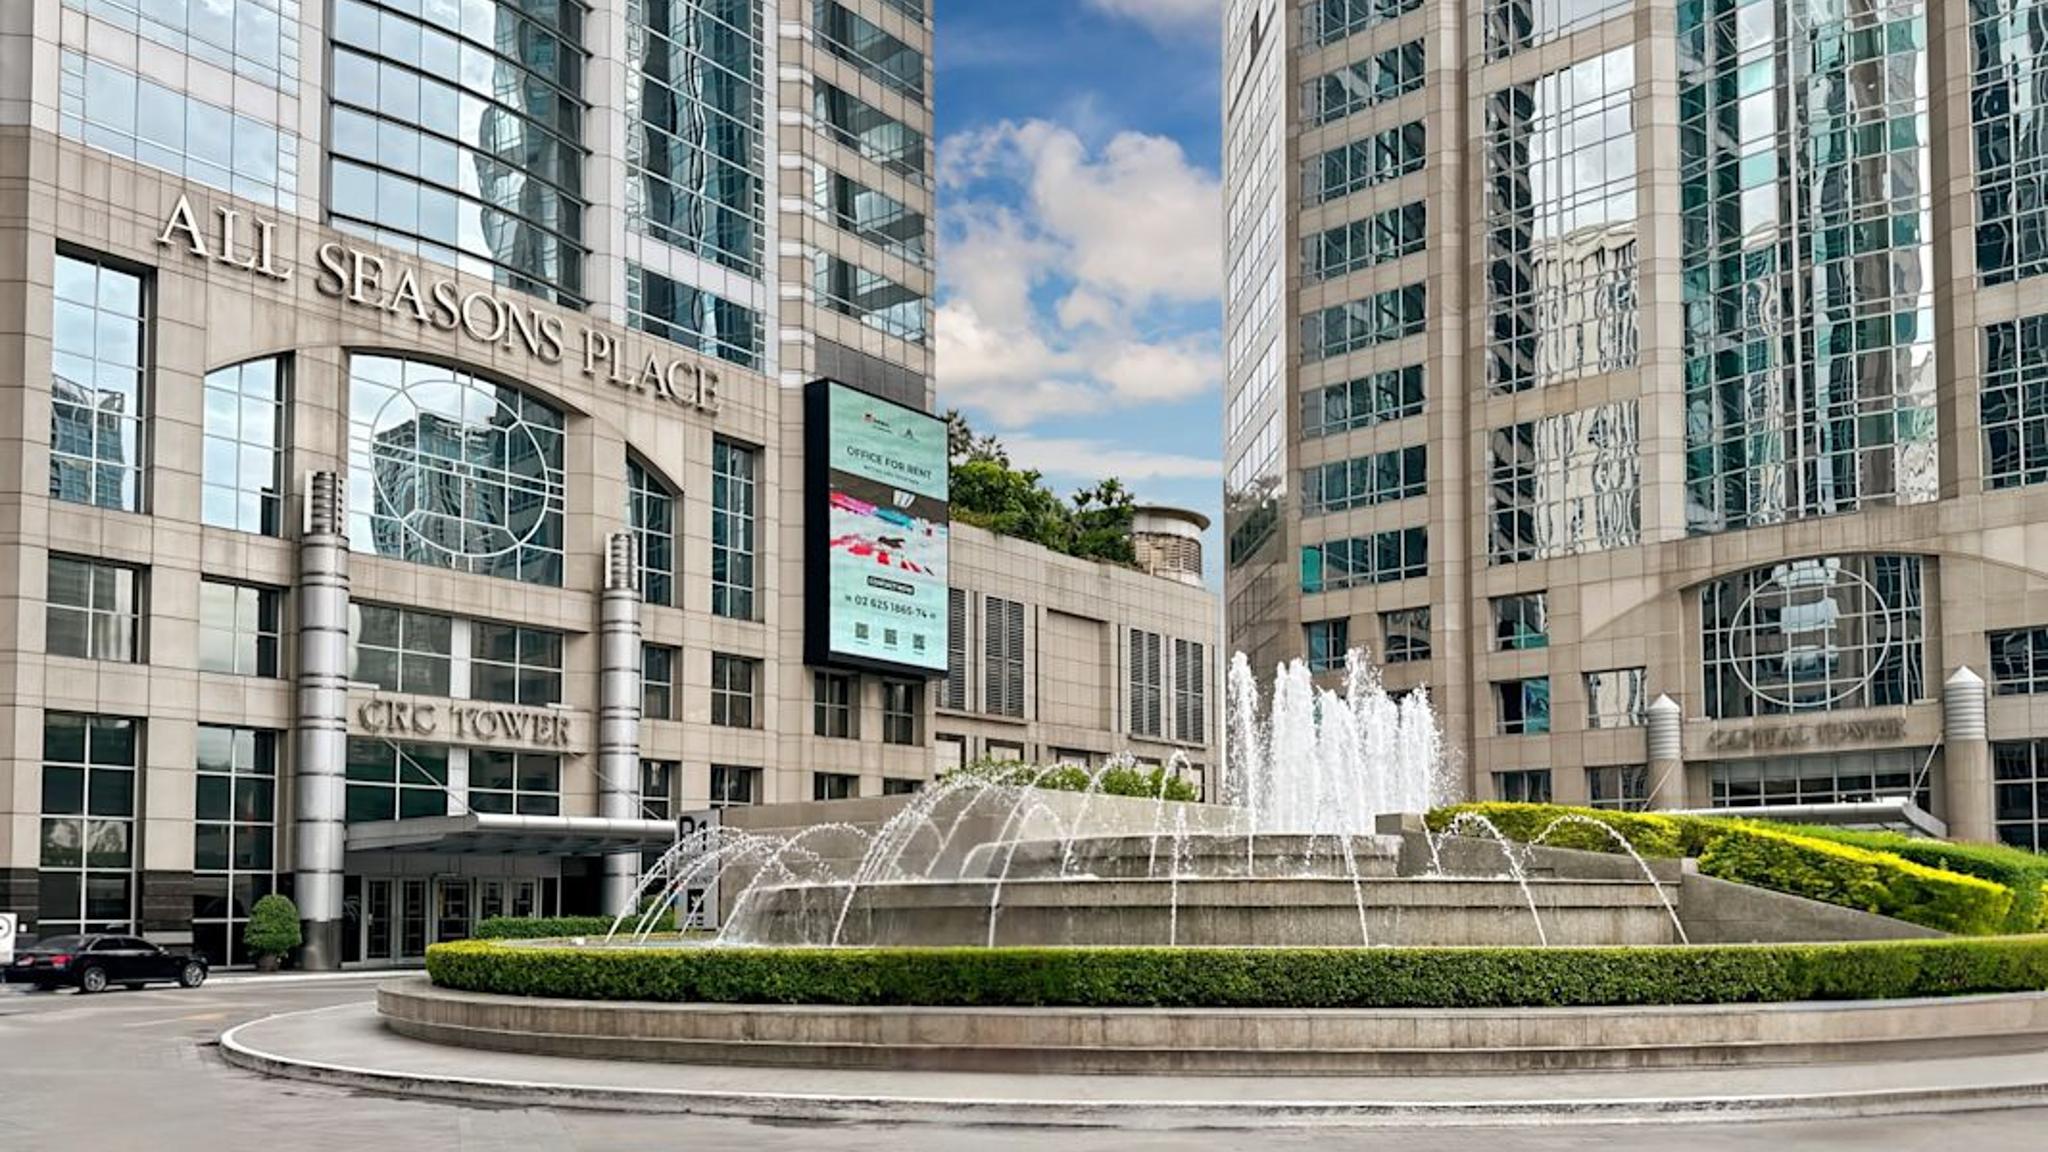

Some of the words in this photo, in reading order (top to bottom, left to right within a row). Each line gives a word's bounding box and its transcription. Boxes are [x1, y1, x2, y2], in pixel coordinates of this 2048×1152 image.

[156, 193, 292, 281] ALL
[315, 241, 565, 364] SEASONS
[581, 326, 722, 416] PLACE
[846, 445, 882, 466] OFFICE
[885, 455, 905, 471] FOR
[906, 463, 932, 480] RENT
[358, 699, 437, 736] CRC
[449, 705, 570, 747] TOWER
